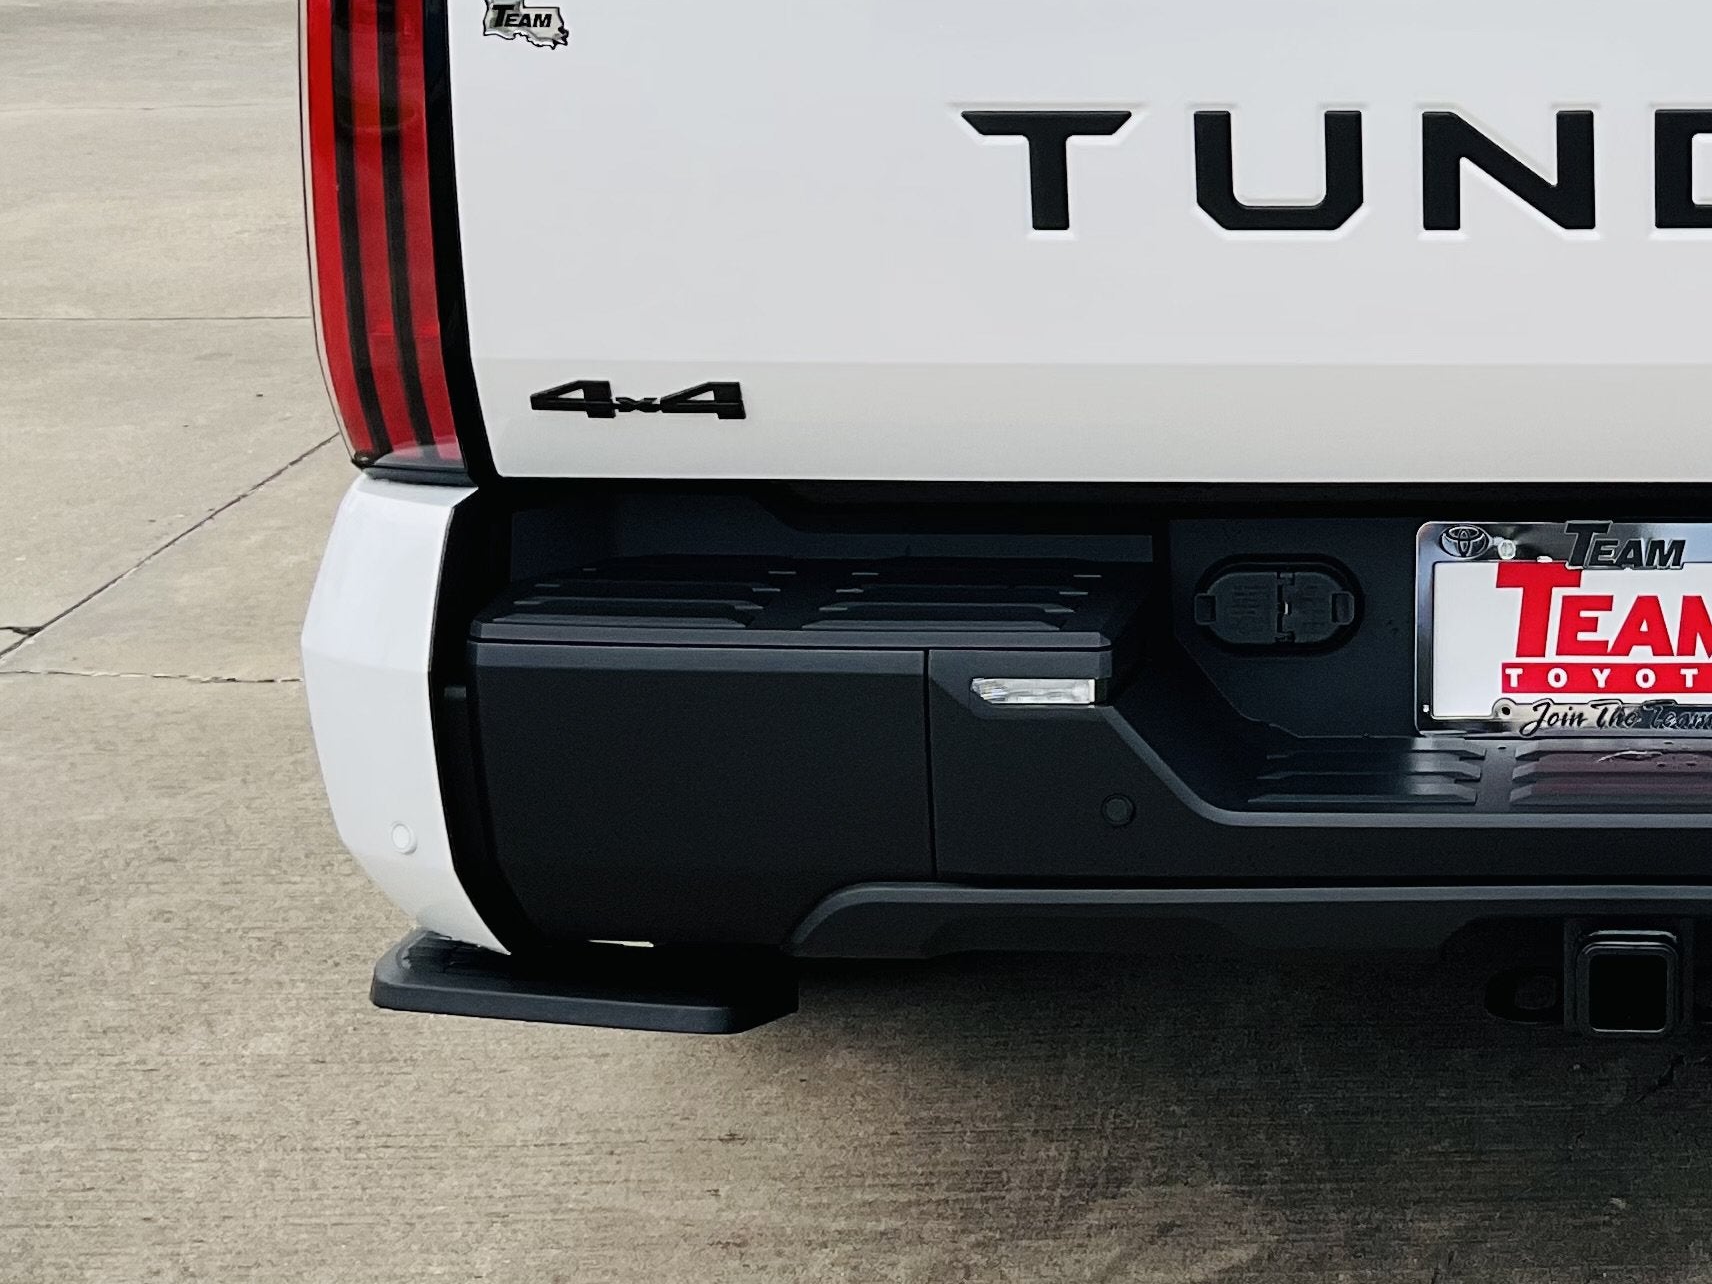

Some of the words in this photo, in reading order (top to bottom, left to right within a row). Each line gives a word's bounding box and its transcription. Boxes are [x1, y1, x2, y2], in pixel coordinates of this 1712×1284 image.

[492, 4, 553, 28] TEAM
[1564, 521, 1686, 570] TEAM
[1519, 699, 1588, 737] Join
[1590, 700, 1640, 729] The
